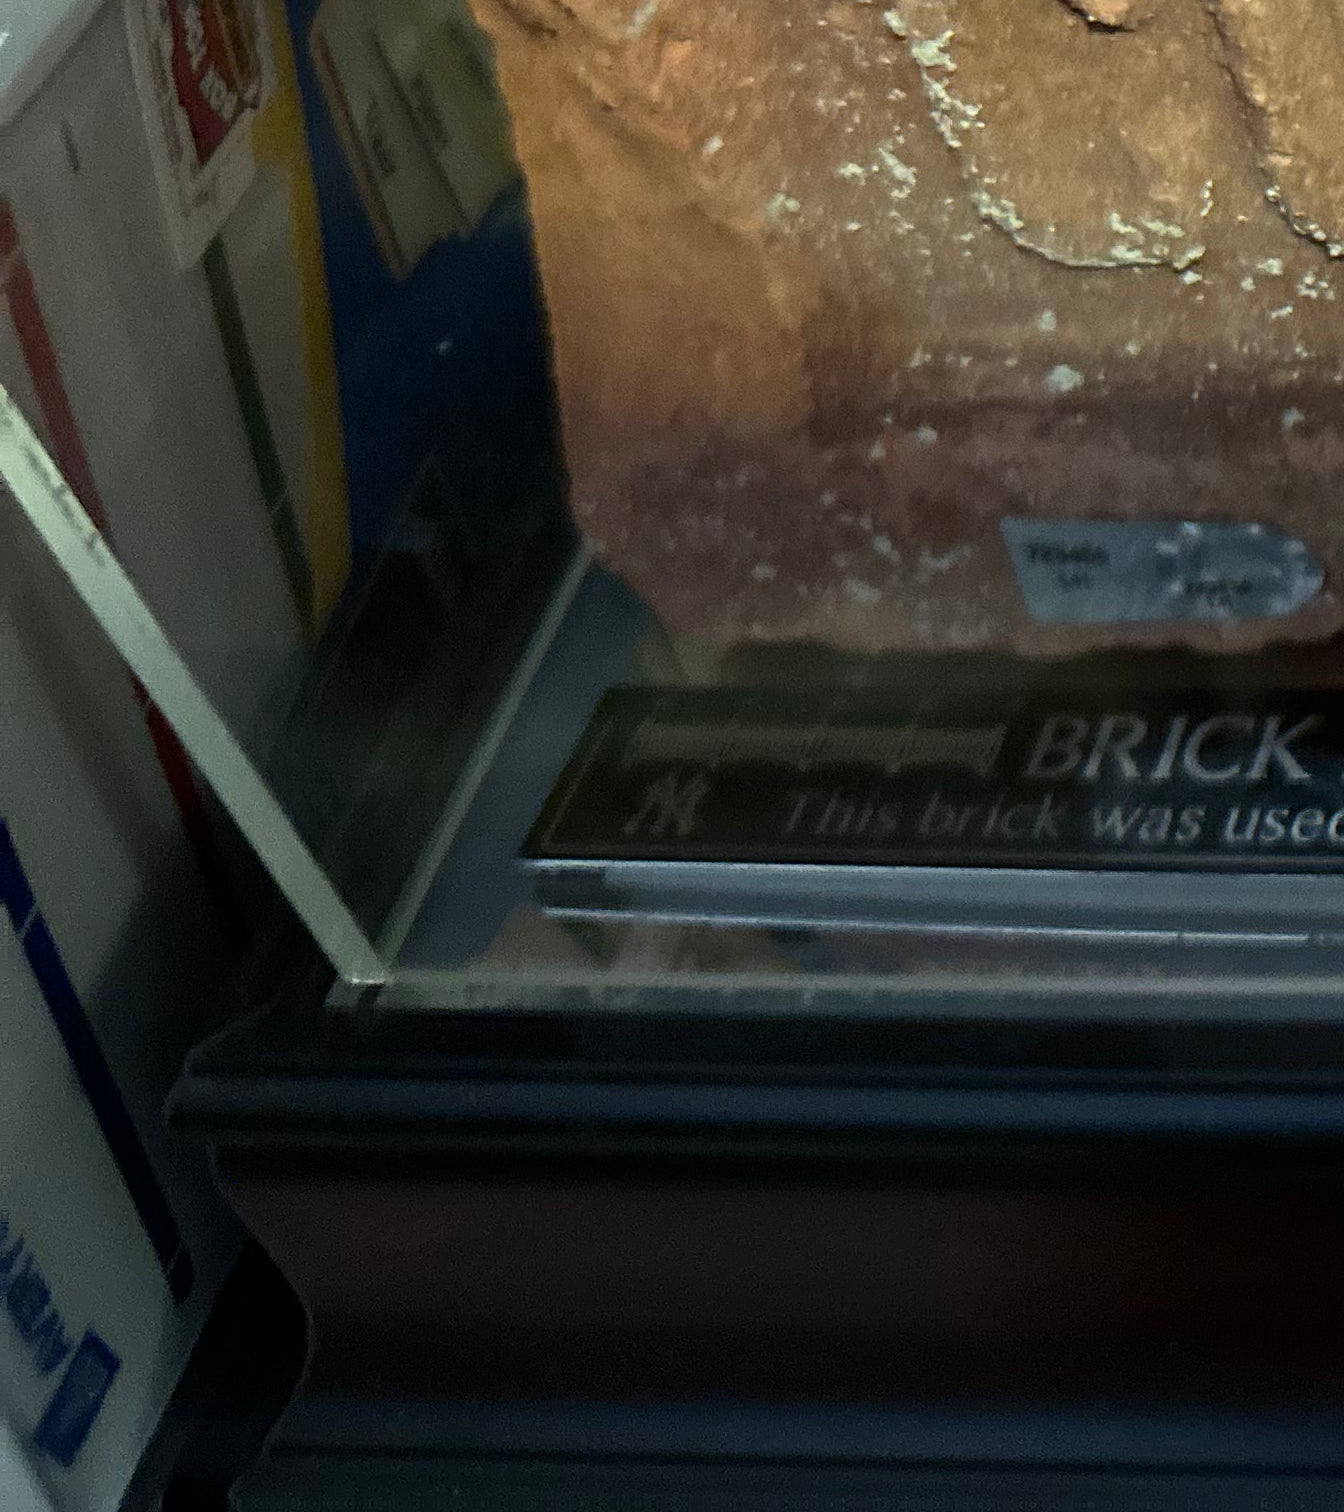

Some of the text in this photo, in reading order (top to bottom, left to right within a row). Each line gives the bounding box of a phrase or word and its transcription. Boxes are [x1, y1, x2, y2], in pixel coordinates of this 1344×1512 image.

[1025, 714, 1318, 784] BRICK
[783, 790, 900, 838] This
[914, 790, 1064, 841] brick
[1091, 799, 1202, 842] was
